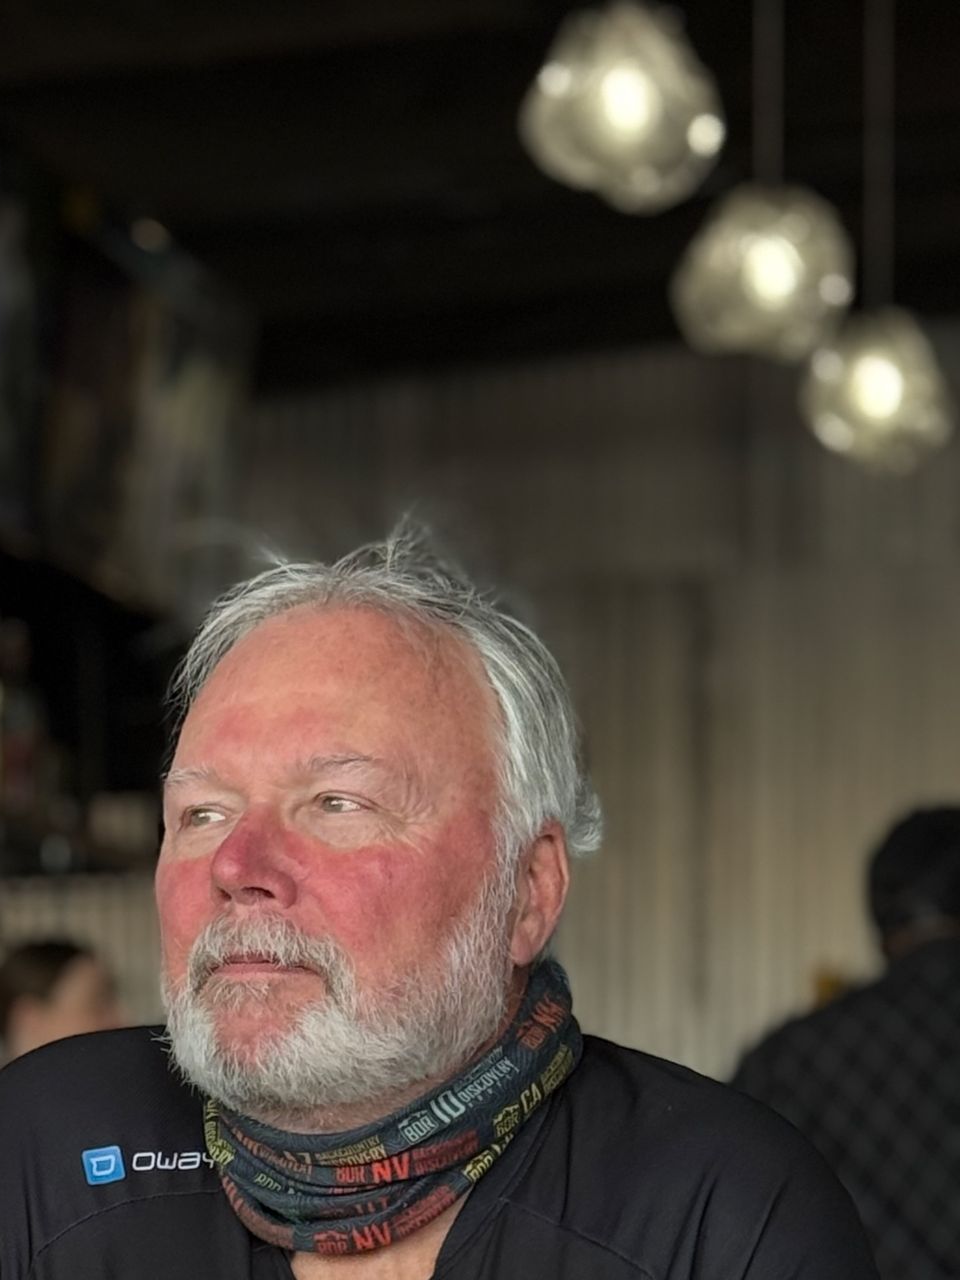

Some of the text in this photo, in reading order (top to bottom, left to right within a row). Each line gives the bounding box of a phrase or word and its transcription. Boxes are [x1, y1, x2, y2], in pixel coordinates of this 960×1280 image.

[404, 1115, 435, 1141] BDR
[457, 1057, 518, 1102] DISCOVERY
[372, 1153, 411, 1185] NV
[352, 1221, 393, 1251] NV
